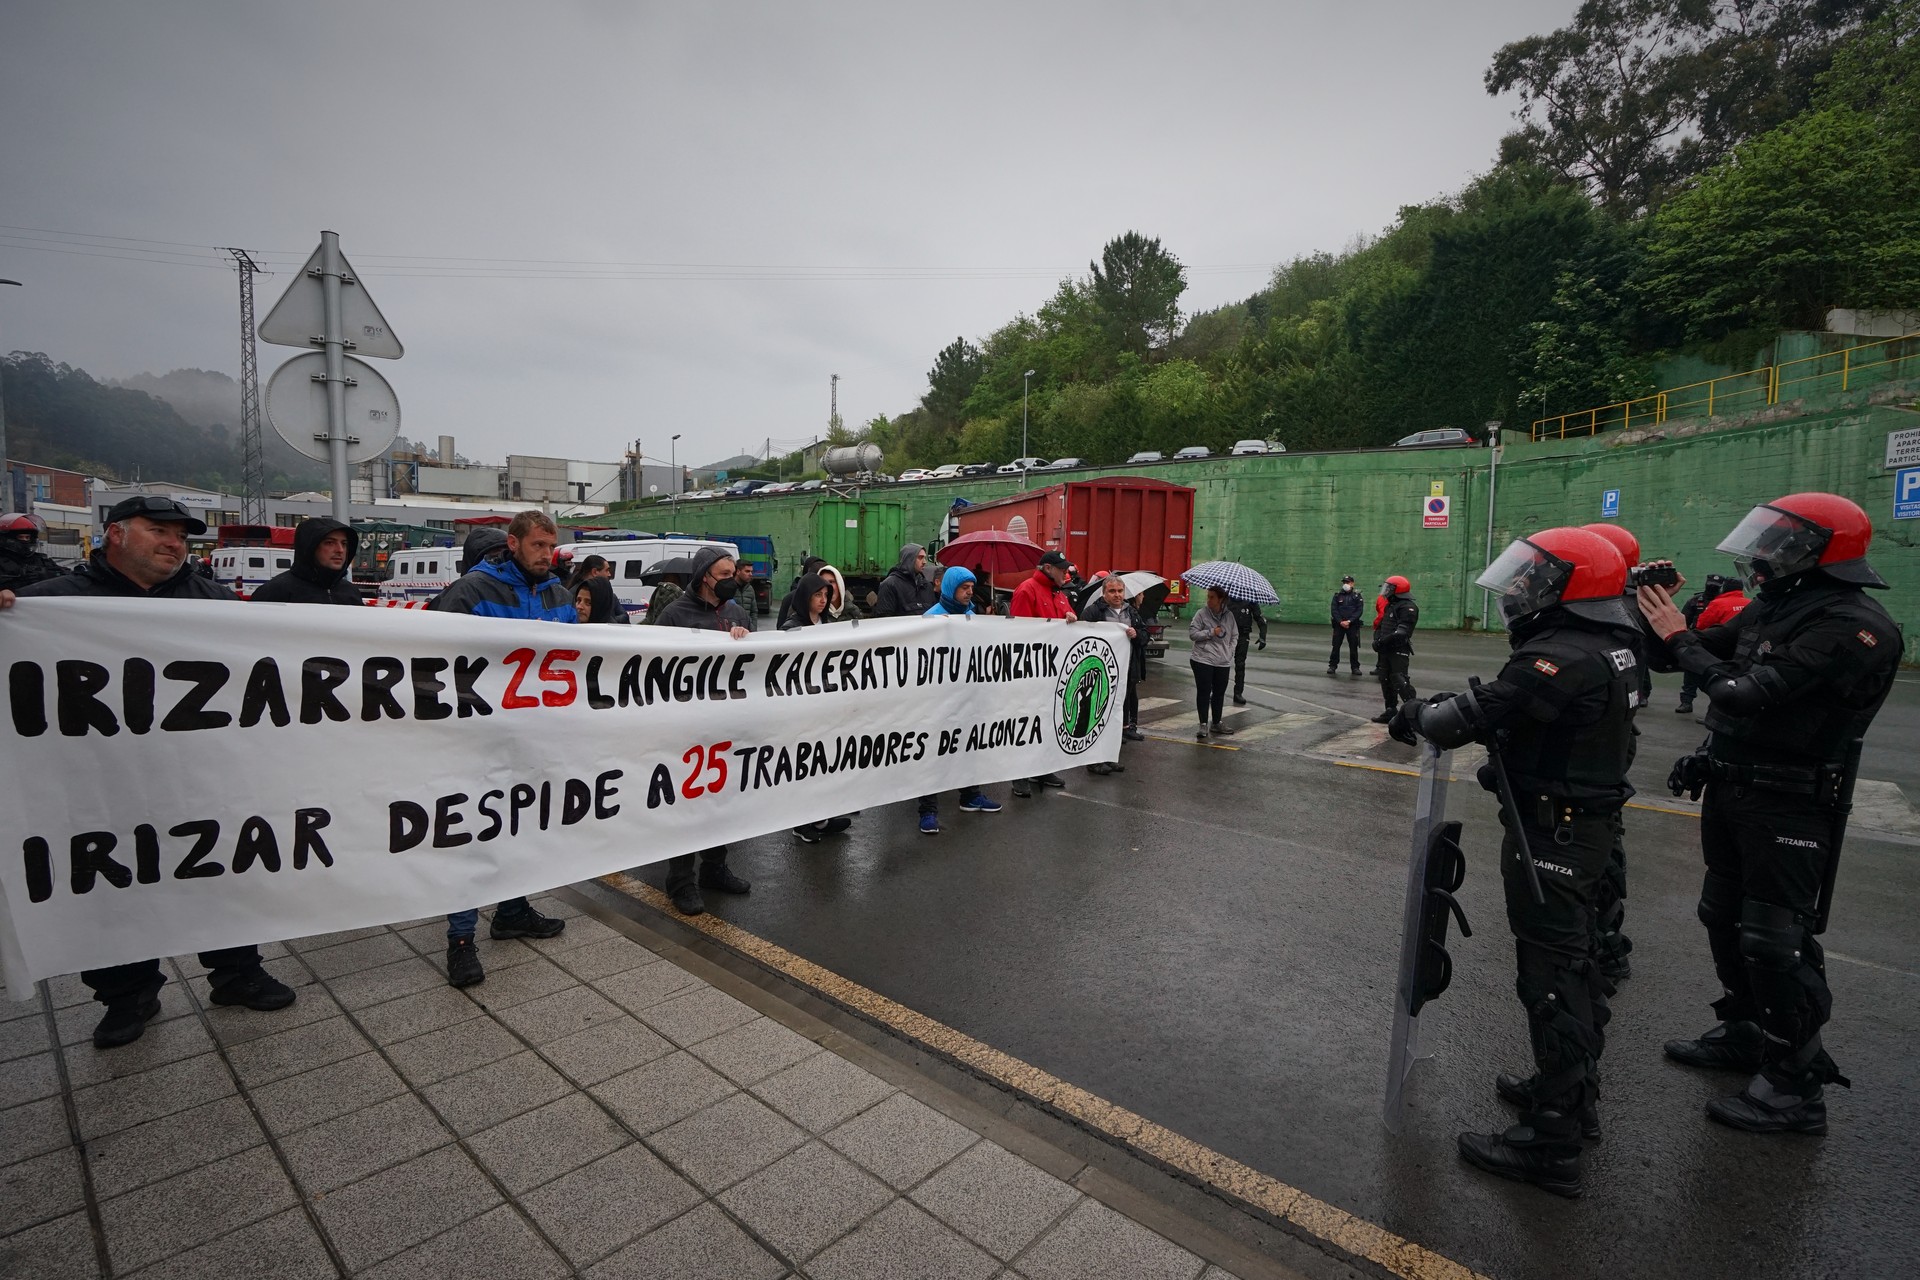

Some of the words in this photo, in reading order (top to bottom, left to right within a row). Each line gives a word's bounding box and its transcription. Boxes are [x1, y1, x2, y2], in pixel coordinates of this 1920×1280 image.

[1606, 492, 1616, 508] P
[1903, 472, 1920, 500] P
[9, 656, 492, 737] IRIZARREK
[502, 648, 580, 709] 25
[586, 653, 755, 709] LANGILE
[765, 645, 909, 696] KALERATU
[917, 646, 961, 686] DITU
[966, 642, 1058, 683] ALCONZATIK
[1057, 641, 1098, 698] ALCONZA
[1058, 718, 1105, 752] BORROKAN
[23, 808, 333, 903] IRIZAR
[389, 770, 623, 853] DESPIDE
[647, 763, 675, 809] A
[681, 741, 732, 799] 25
[734, 731, 929, 792] TRABAJADORES
[937, 727, 962, 756] DE
[966, 715, 1043, 752] ALCONZA
